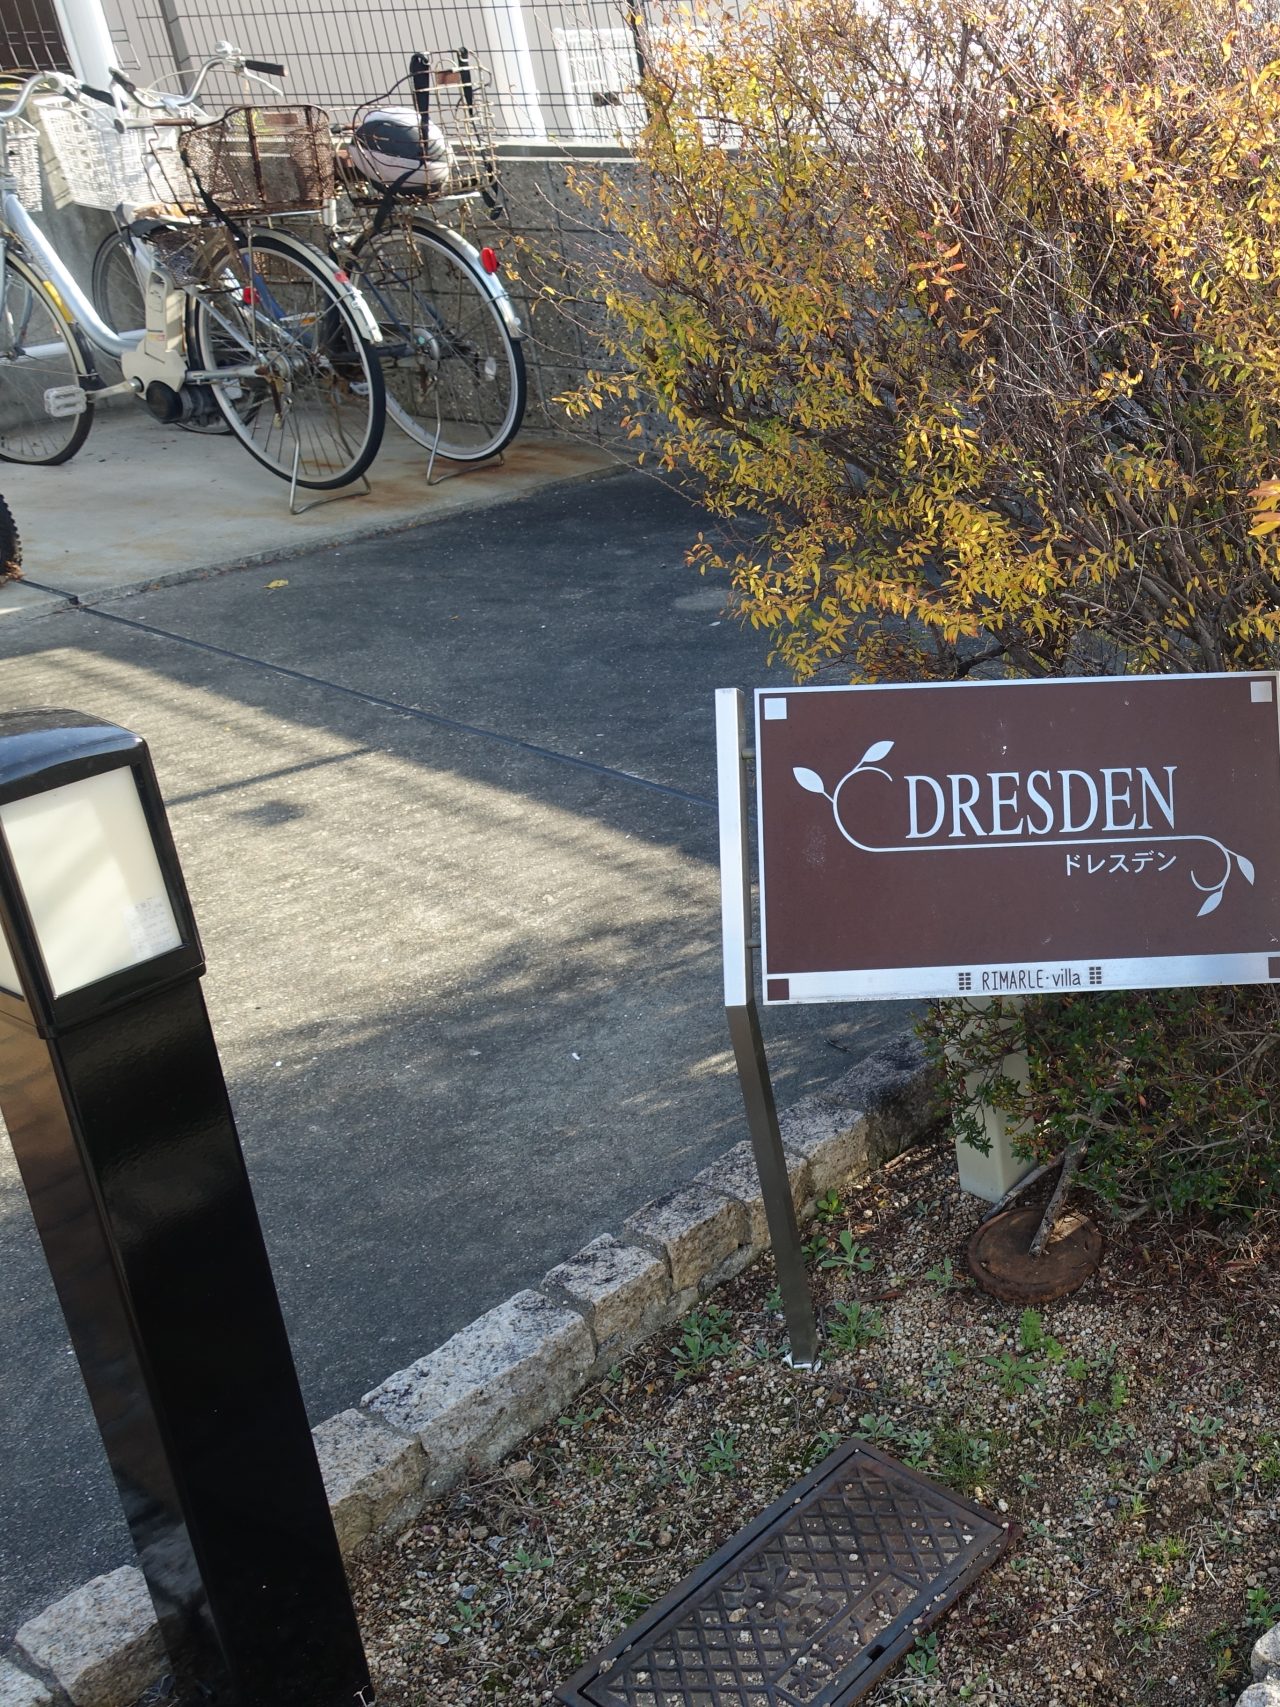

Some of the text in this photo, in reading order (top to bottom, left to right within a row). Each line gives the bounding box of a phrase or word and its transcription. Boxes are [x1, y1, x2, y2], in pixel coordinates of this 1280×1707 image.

[903, 766, 1177, 839] DRESDEN
[1066, 850, 1177, 876] ドレスデン
